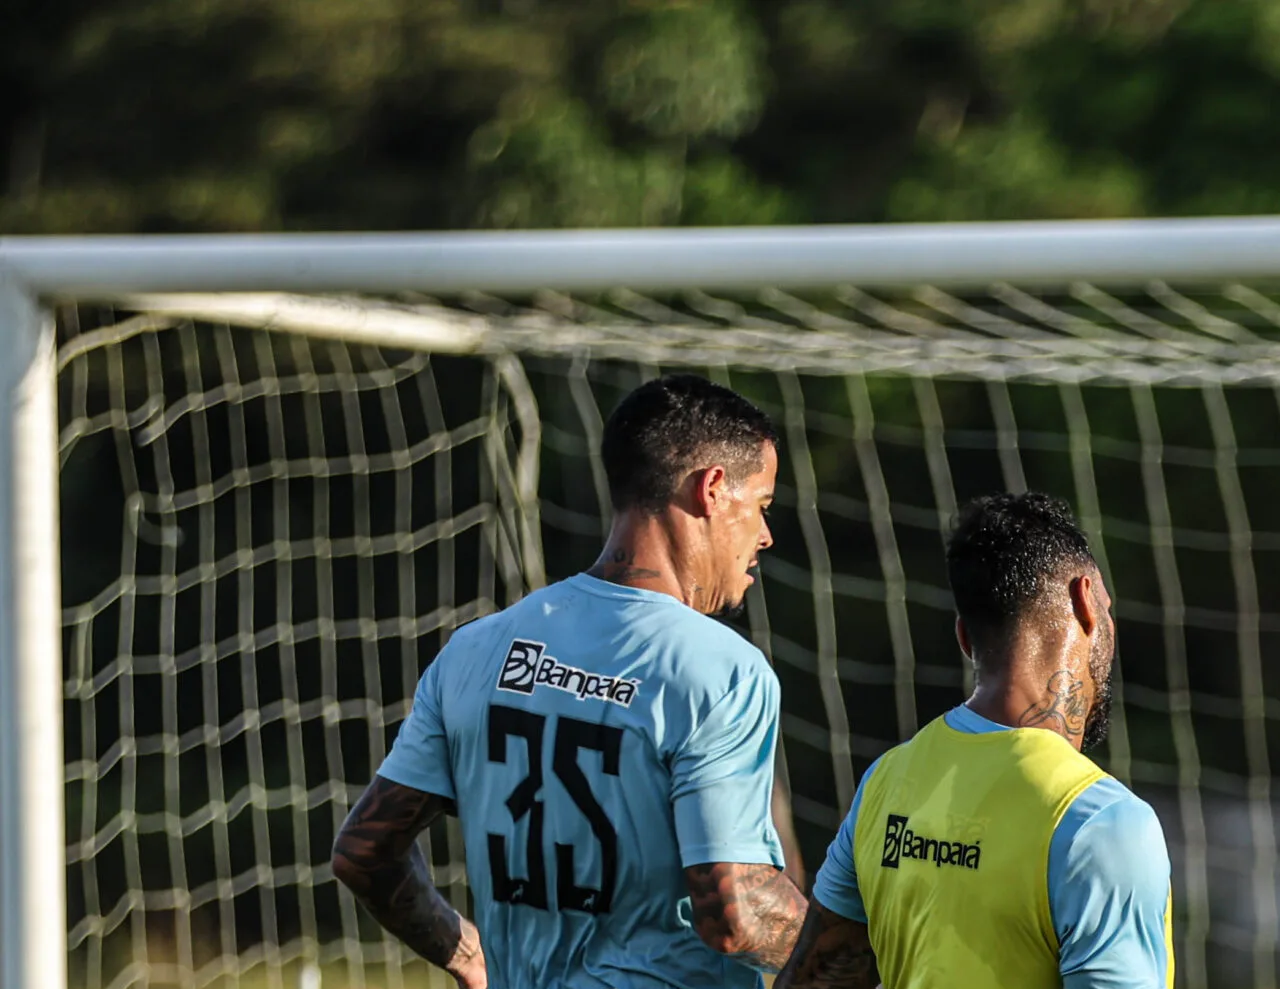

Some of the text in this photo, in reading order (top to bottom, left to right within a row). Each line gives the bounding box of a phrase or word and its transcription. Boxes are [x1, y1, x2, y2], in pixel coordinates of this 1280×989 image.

[535, 657, 638, 704] Banpará
[487, 704, 624, 913] 35
[901, 829, 981, 870] Banpará
